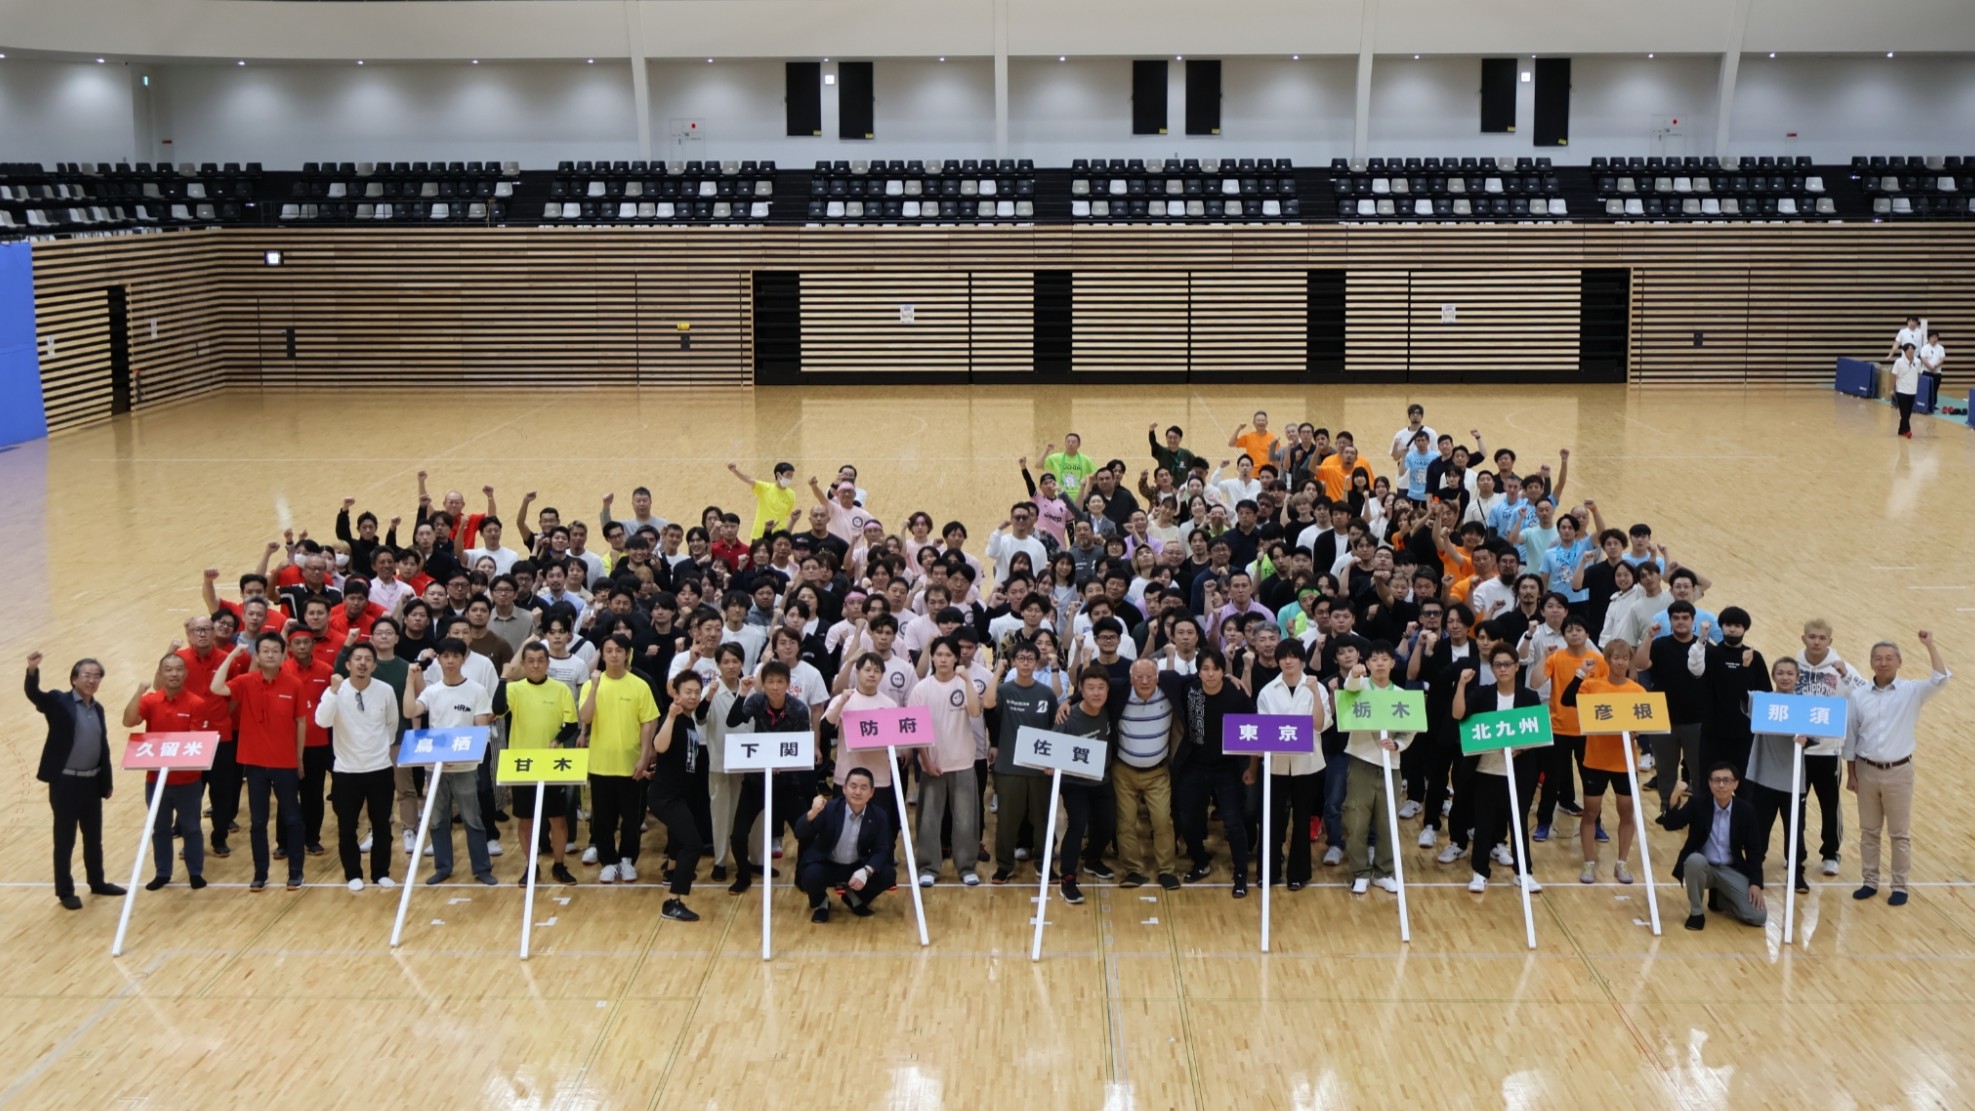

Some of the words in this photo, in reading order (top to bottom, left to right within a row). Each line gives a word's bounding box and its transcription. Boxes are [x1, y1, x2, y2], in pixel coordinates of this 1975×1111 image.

[1353, 701, 1410, 718] 栃木
[1594, 703, 1653, 720] 彦根
[1768, 703, 1830, 724] 那須
[859, 717, 917, 737] 防府
[1239, 724, 1297, 741] 東京
[1472, 716, 1539, 740] 北九州
[136, 741, 204, 757] 久留米
[414, 736, 472, 753] 鳥栖
[741, 742, 798, 758] 下関
[1033, 738, 1090, 764] 佐賀
[514, 757, 572, 772] 甘木
